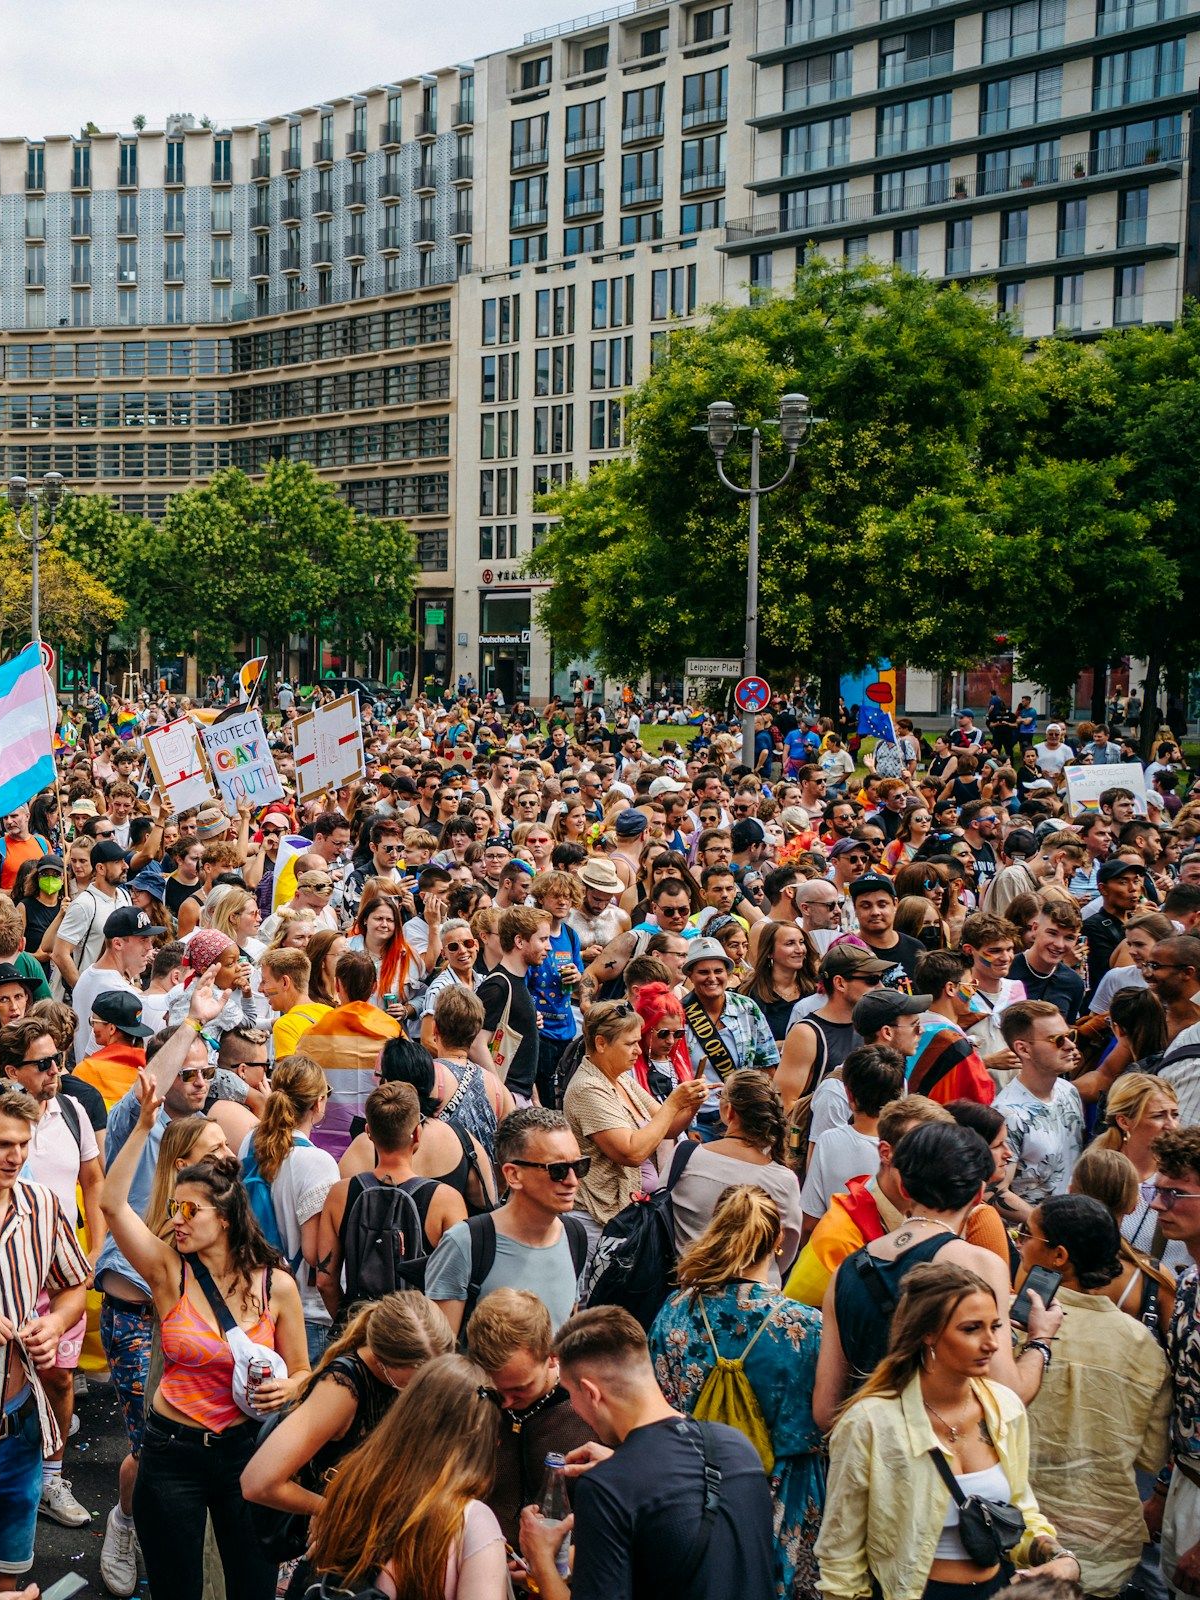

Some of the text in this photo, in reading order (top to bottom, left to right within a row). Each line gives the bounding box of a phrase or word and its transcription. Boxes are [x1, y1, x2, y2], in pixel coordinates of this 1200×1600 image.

[479, 635, 520, 643] Deutsche Bank
[690, 662, 739, 673] Leipziger Platz
[205, 719, 259, 749] PROTECT
[214, 739, 260, 772] GAY
[221, 765, 277, 800] YOUTH
[686, 1001, 714, 1038] MAID
[704, 1039, 727, 1057] OF
